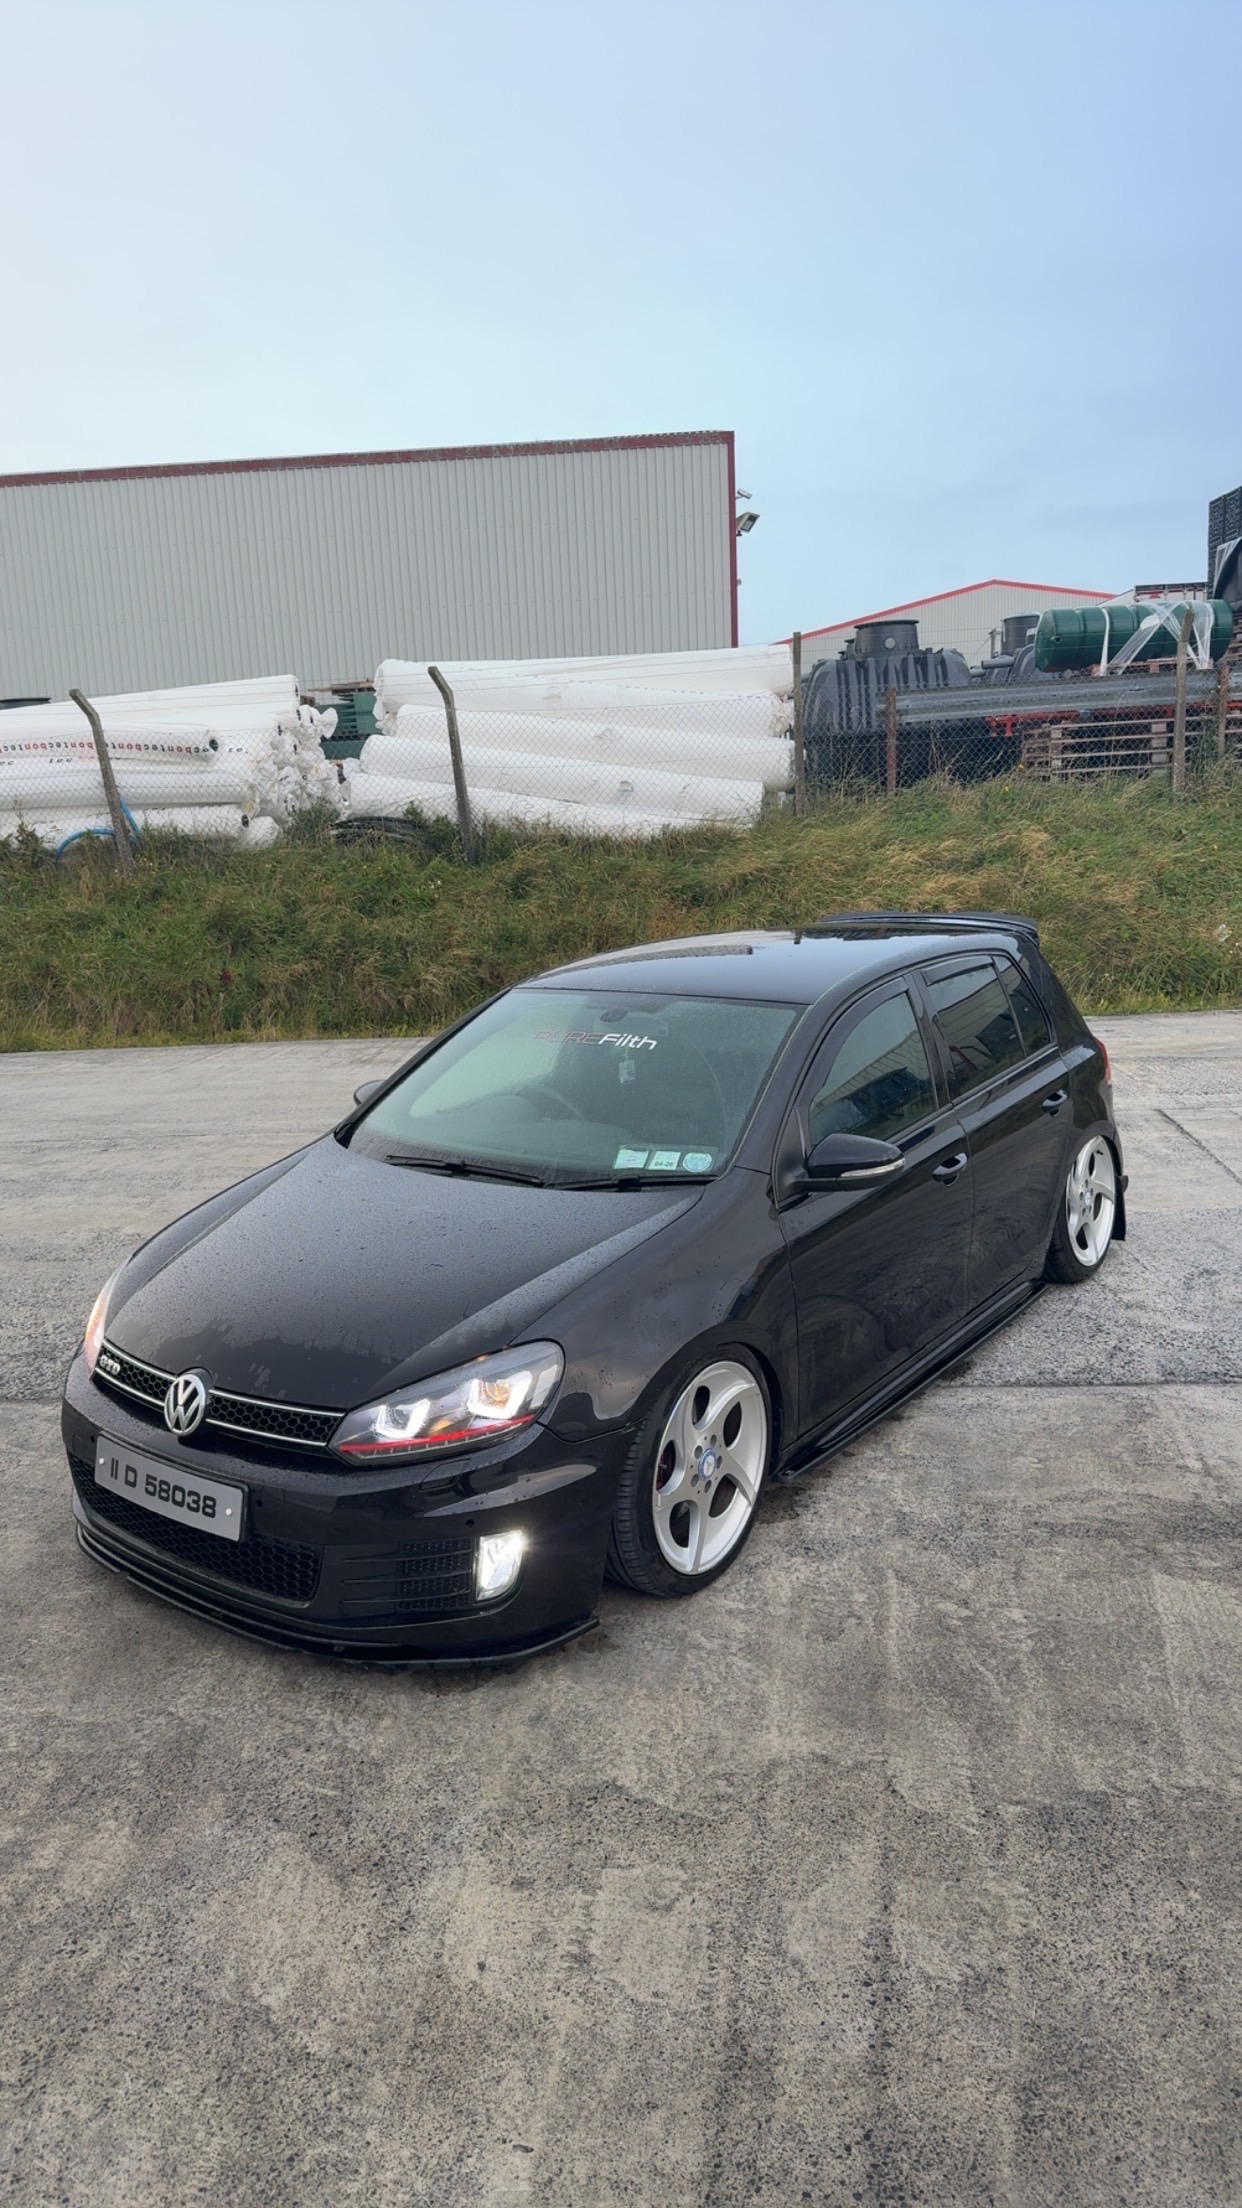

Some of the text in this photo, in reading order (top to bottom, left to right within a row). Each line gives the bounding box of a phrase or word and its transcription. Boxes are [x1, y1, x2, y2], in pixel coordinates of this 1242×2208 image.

[99, 1354, 121, 1376] GTD
[124, 1464, 137, 1488] D
[144, 1474, 216, 1518] 58038
